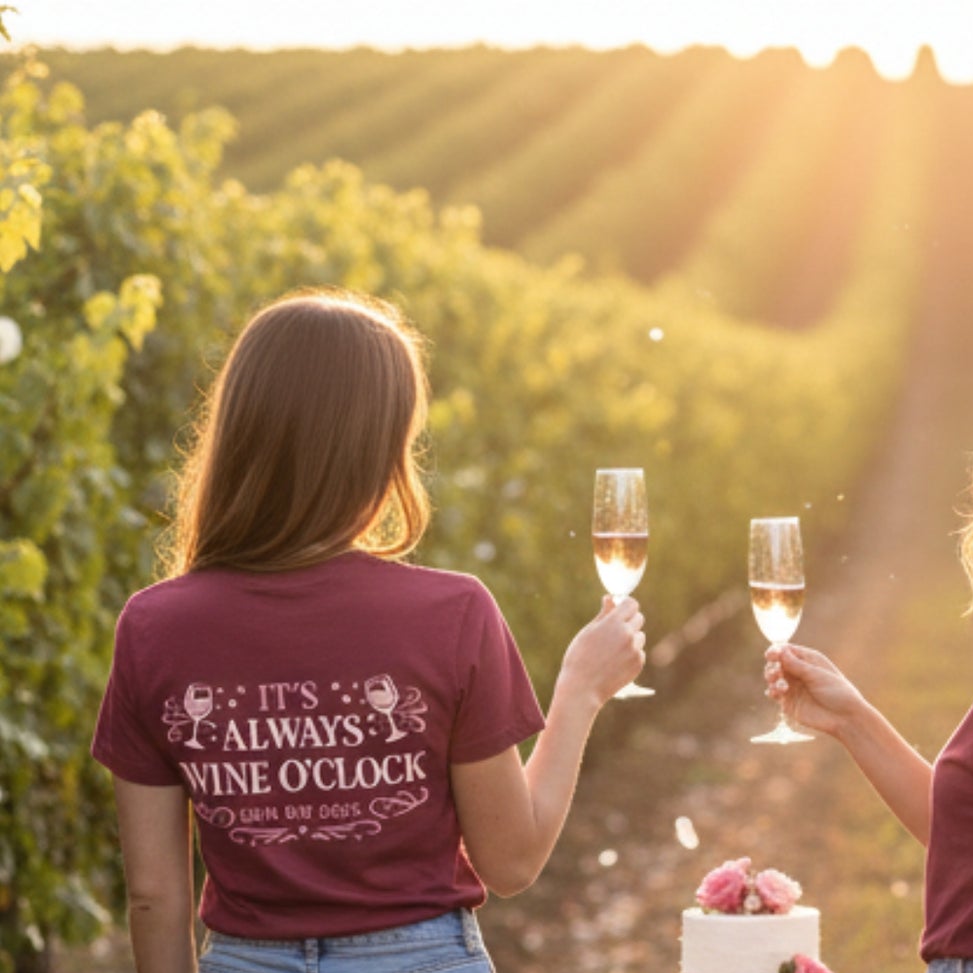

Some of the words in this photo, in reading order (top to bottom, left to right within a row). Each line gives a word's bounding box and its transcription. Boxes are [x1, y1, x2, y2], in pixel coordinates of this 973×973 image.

[258, 681, 319, 711] IT'S
[223, 715, 364, 751] ALWAYS
[179, 762, 272, 796] WINE
[278, 751, 427, 793] O'CLOCK
